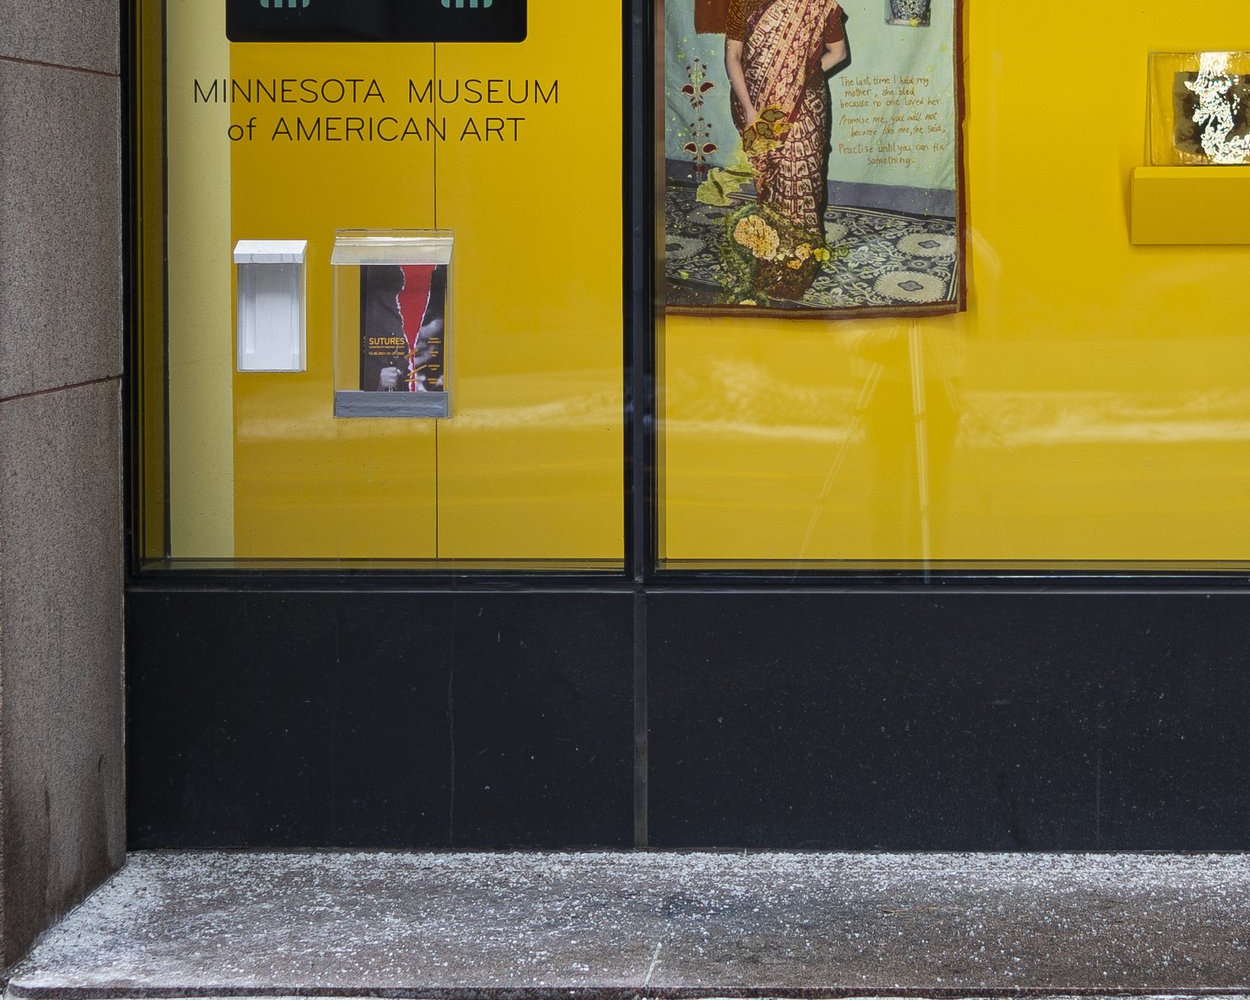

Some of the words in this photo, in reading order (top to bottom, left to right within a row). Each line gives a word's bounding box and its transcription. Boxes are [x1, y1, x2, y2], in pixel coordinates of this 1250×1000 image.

[838, 76, 854, 88] The
[856, 76, 872, 86] last
[872, 76, 890, 85] time
[916, 76, 930, 88] my
[193, 78, 386, 104] MINNESOTA
[408, 78, 560, 104] MUSEUM
[882, 86, 894, 96] she
[840, 99, 869, 108] because
[904, 98, 924, 106] loved
[891, 114, 905, 124] you
[227, 116, 257, 142] of
[271, 116, 447, 142] AMERICAN
[459, 117, 526, 142] ART
[368, 337, 406, 346] SUTURES
